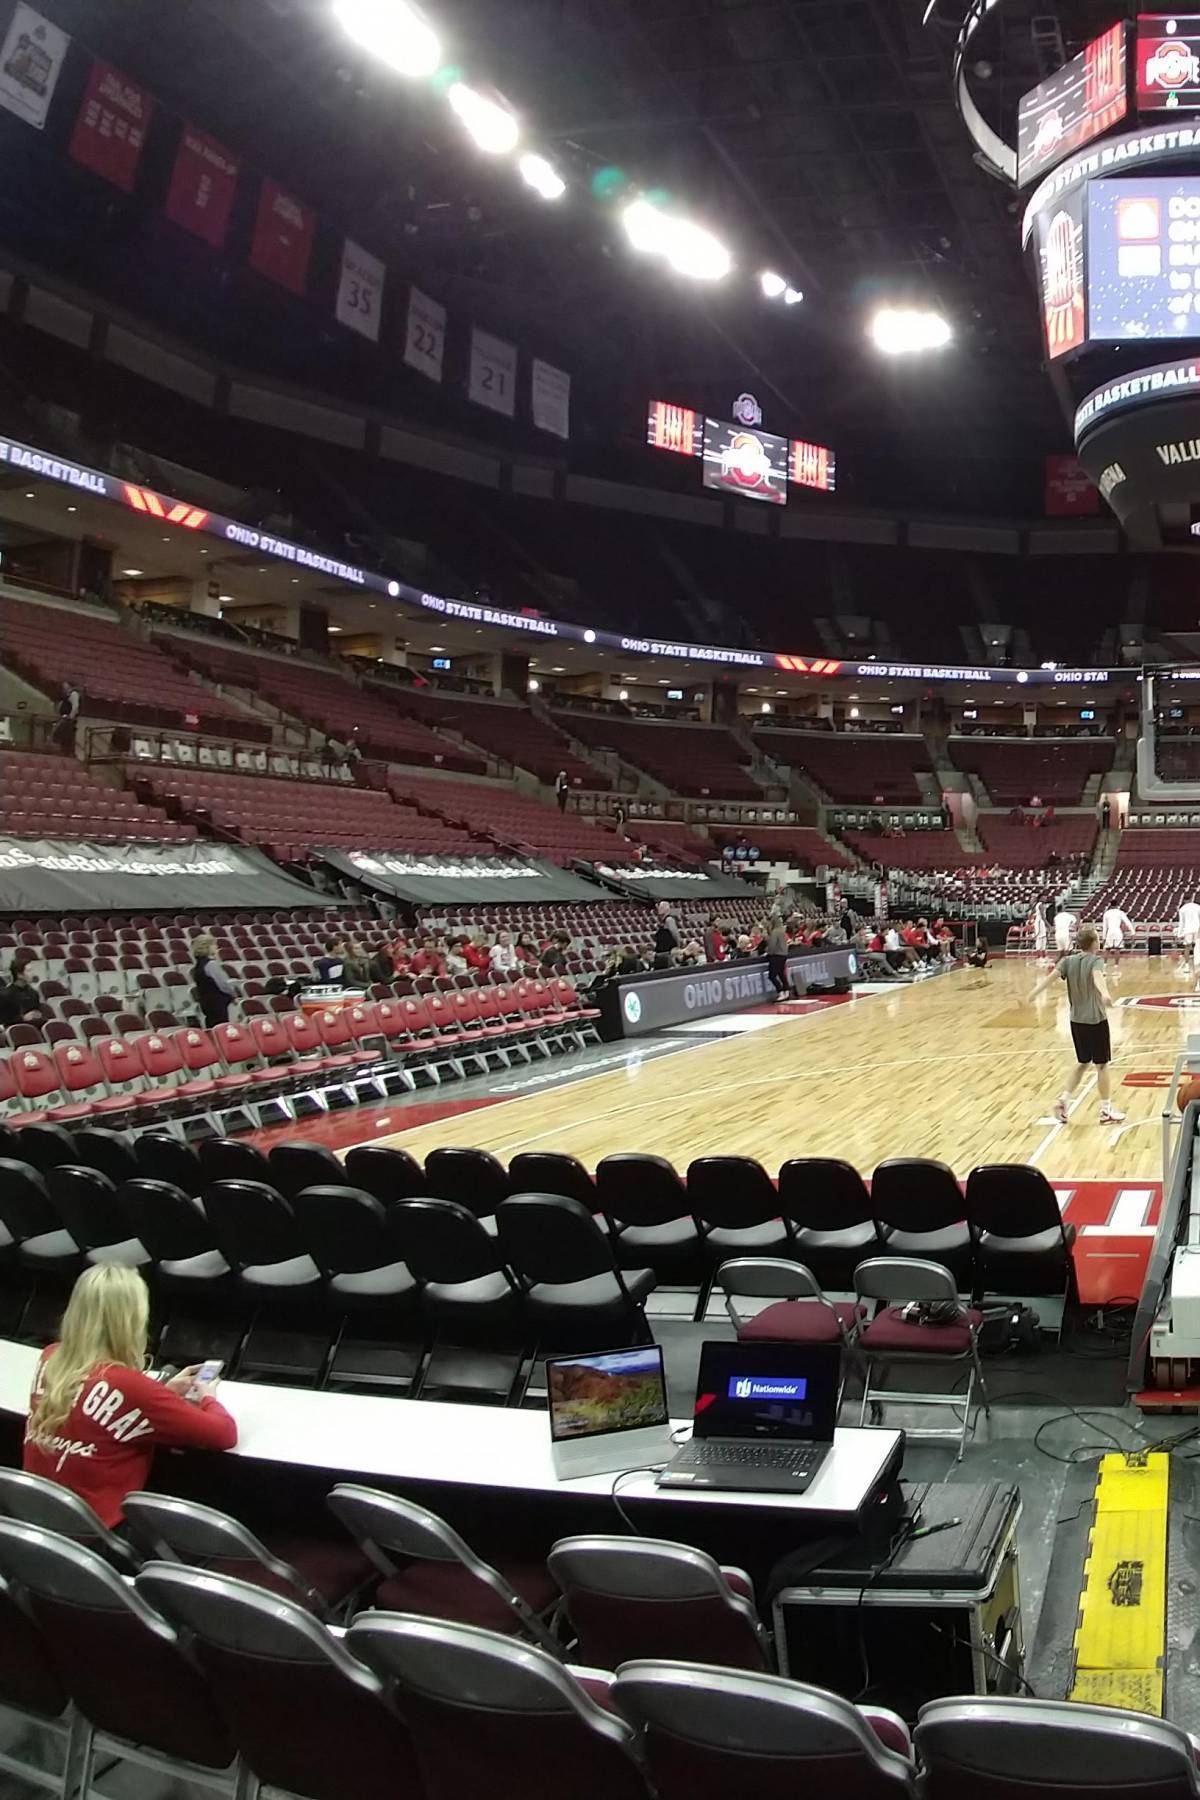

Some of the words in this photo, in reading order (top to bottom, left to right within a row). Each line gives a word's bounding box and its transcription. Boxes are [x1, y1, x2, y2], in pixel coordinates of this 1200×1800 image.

[348, 280, 371, 315] 35
[413, 324, 437, 359] 22
[481, 366, 505, 396] 21
[1095, 366, 1200, 410] BASKETBALL
[10, 446, 106, 494] BASKETBALL
[225, 524, 260, 547] OHIO
[260, 535, 296, 560] STATE
[296, 549, 365, 584] BASKETBALL
[421, 593, 445, 611] OHIO
[445, 602, 482, 620] STATE
[483, 610, 558, 635] BASKETBALL
[621, 637, 649, 652] OHIO
[650, 642, 688, 657] STATE
[689, 647, 763, 665] BASKETBALL
[858, 665, 888, 677] OHIO
[888, 666, 922, 678] STATE
[922, 668, 991, 681] BASKETBALL
[1054, 671, 1082, 682] OHIO
[684, 979, 722, 1009] OHIO
[725, 971, 764, 999] STATE
[752, 1384, 797, 1394] Nationwide
[82, 1380, 155, 1443] GRAY
